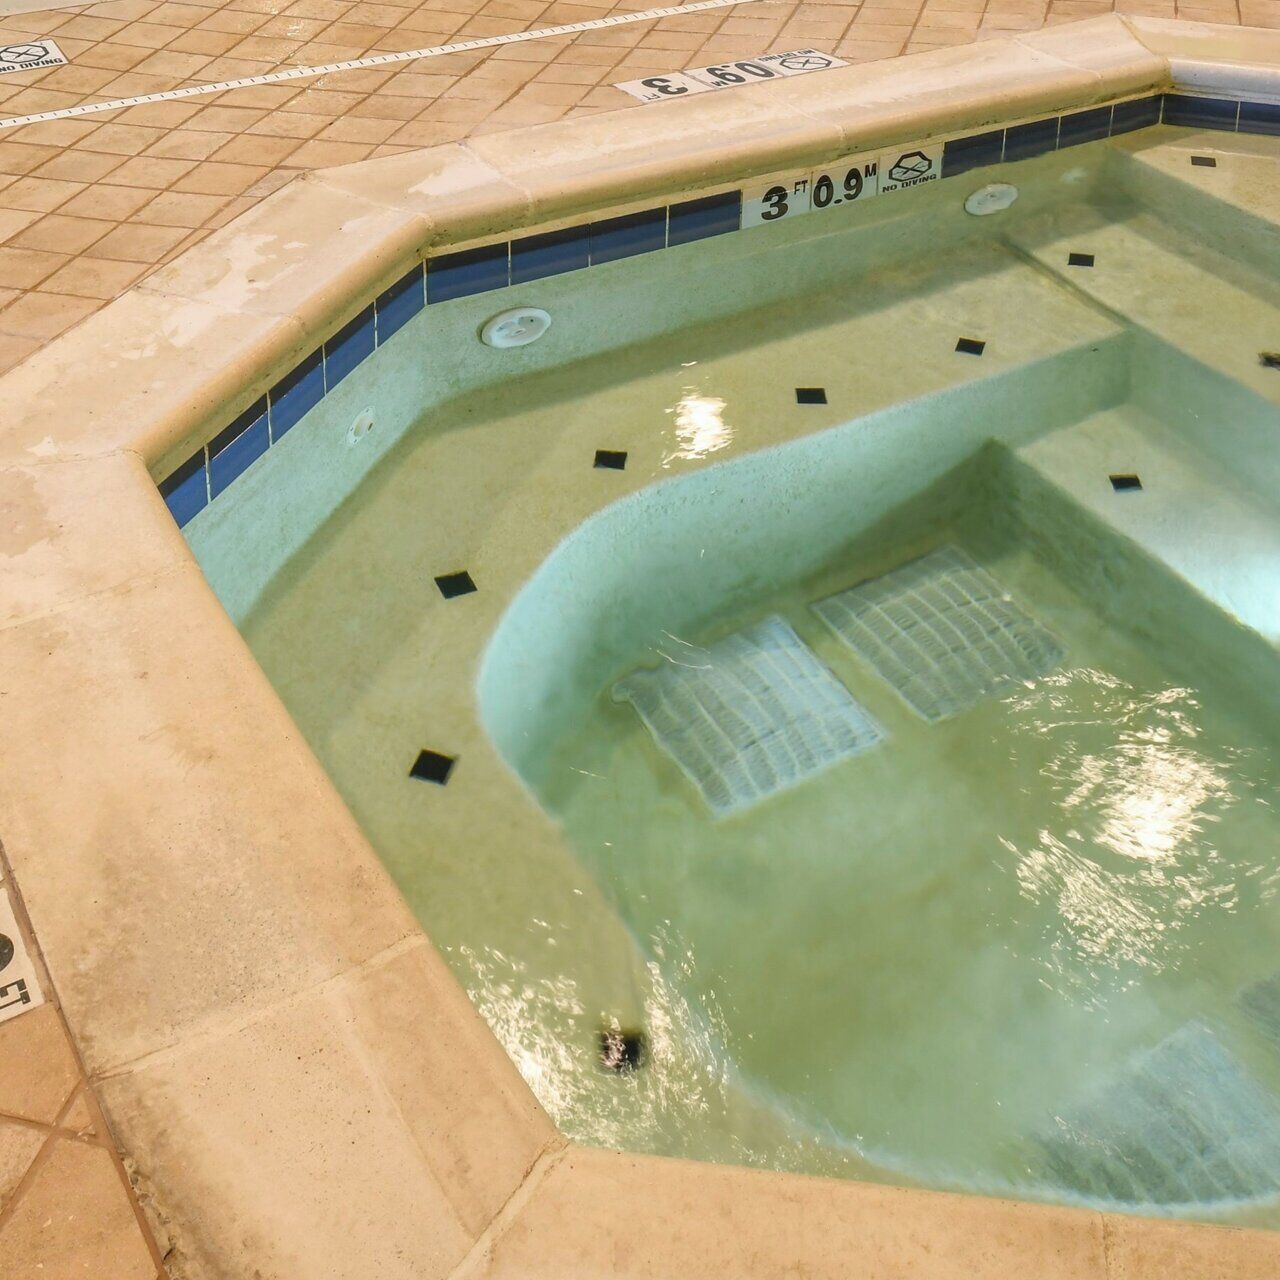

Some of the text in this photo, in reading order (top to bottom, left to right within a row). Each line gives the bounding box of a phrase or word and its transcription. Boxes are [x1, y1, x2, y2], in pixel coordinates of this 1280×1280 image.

[19, 57, 63, 69] DIVING
[641, 78, 688, 95] 3
[882, 173, 937, 193] NO DIVING
[761, 186, 789, 220] 3
